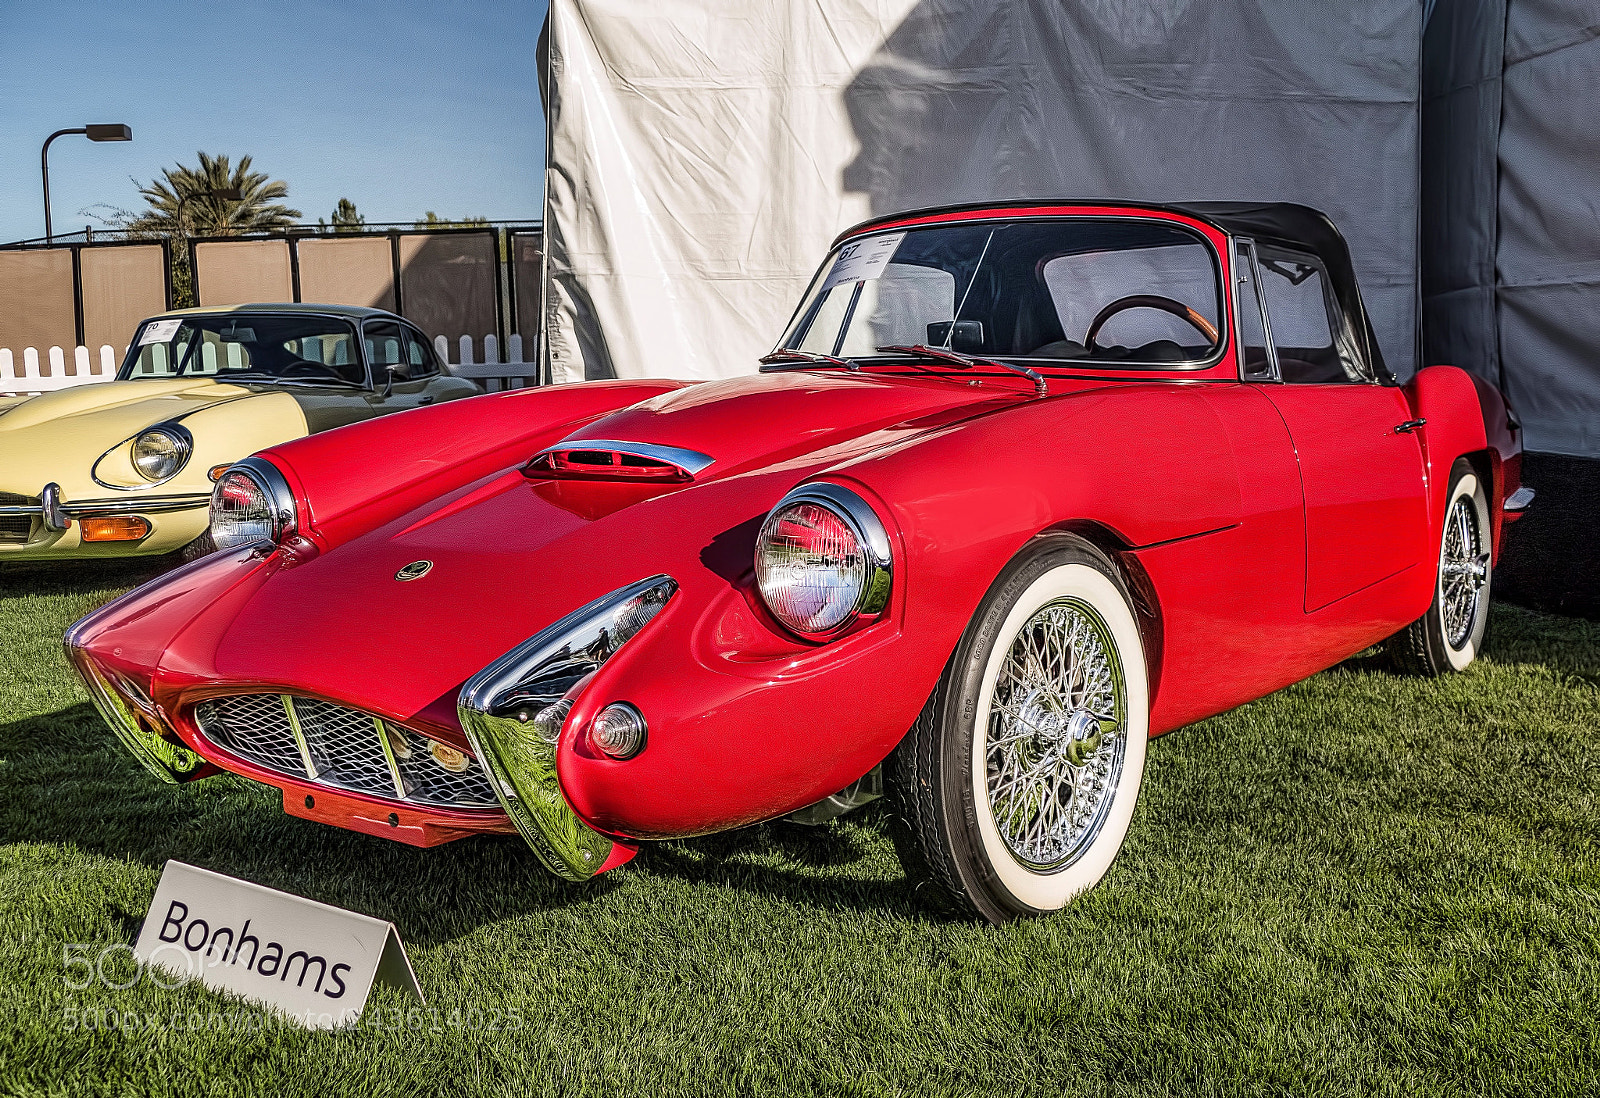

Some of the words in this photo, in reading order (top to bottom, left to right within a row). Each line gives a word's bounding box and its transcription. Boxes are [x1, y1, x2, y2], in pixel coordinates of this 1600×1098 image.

[839, 243, 861, 260] 67
[148, 322, 159, 331] 70
[158, 900, 351, 999] Bonhams
